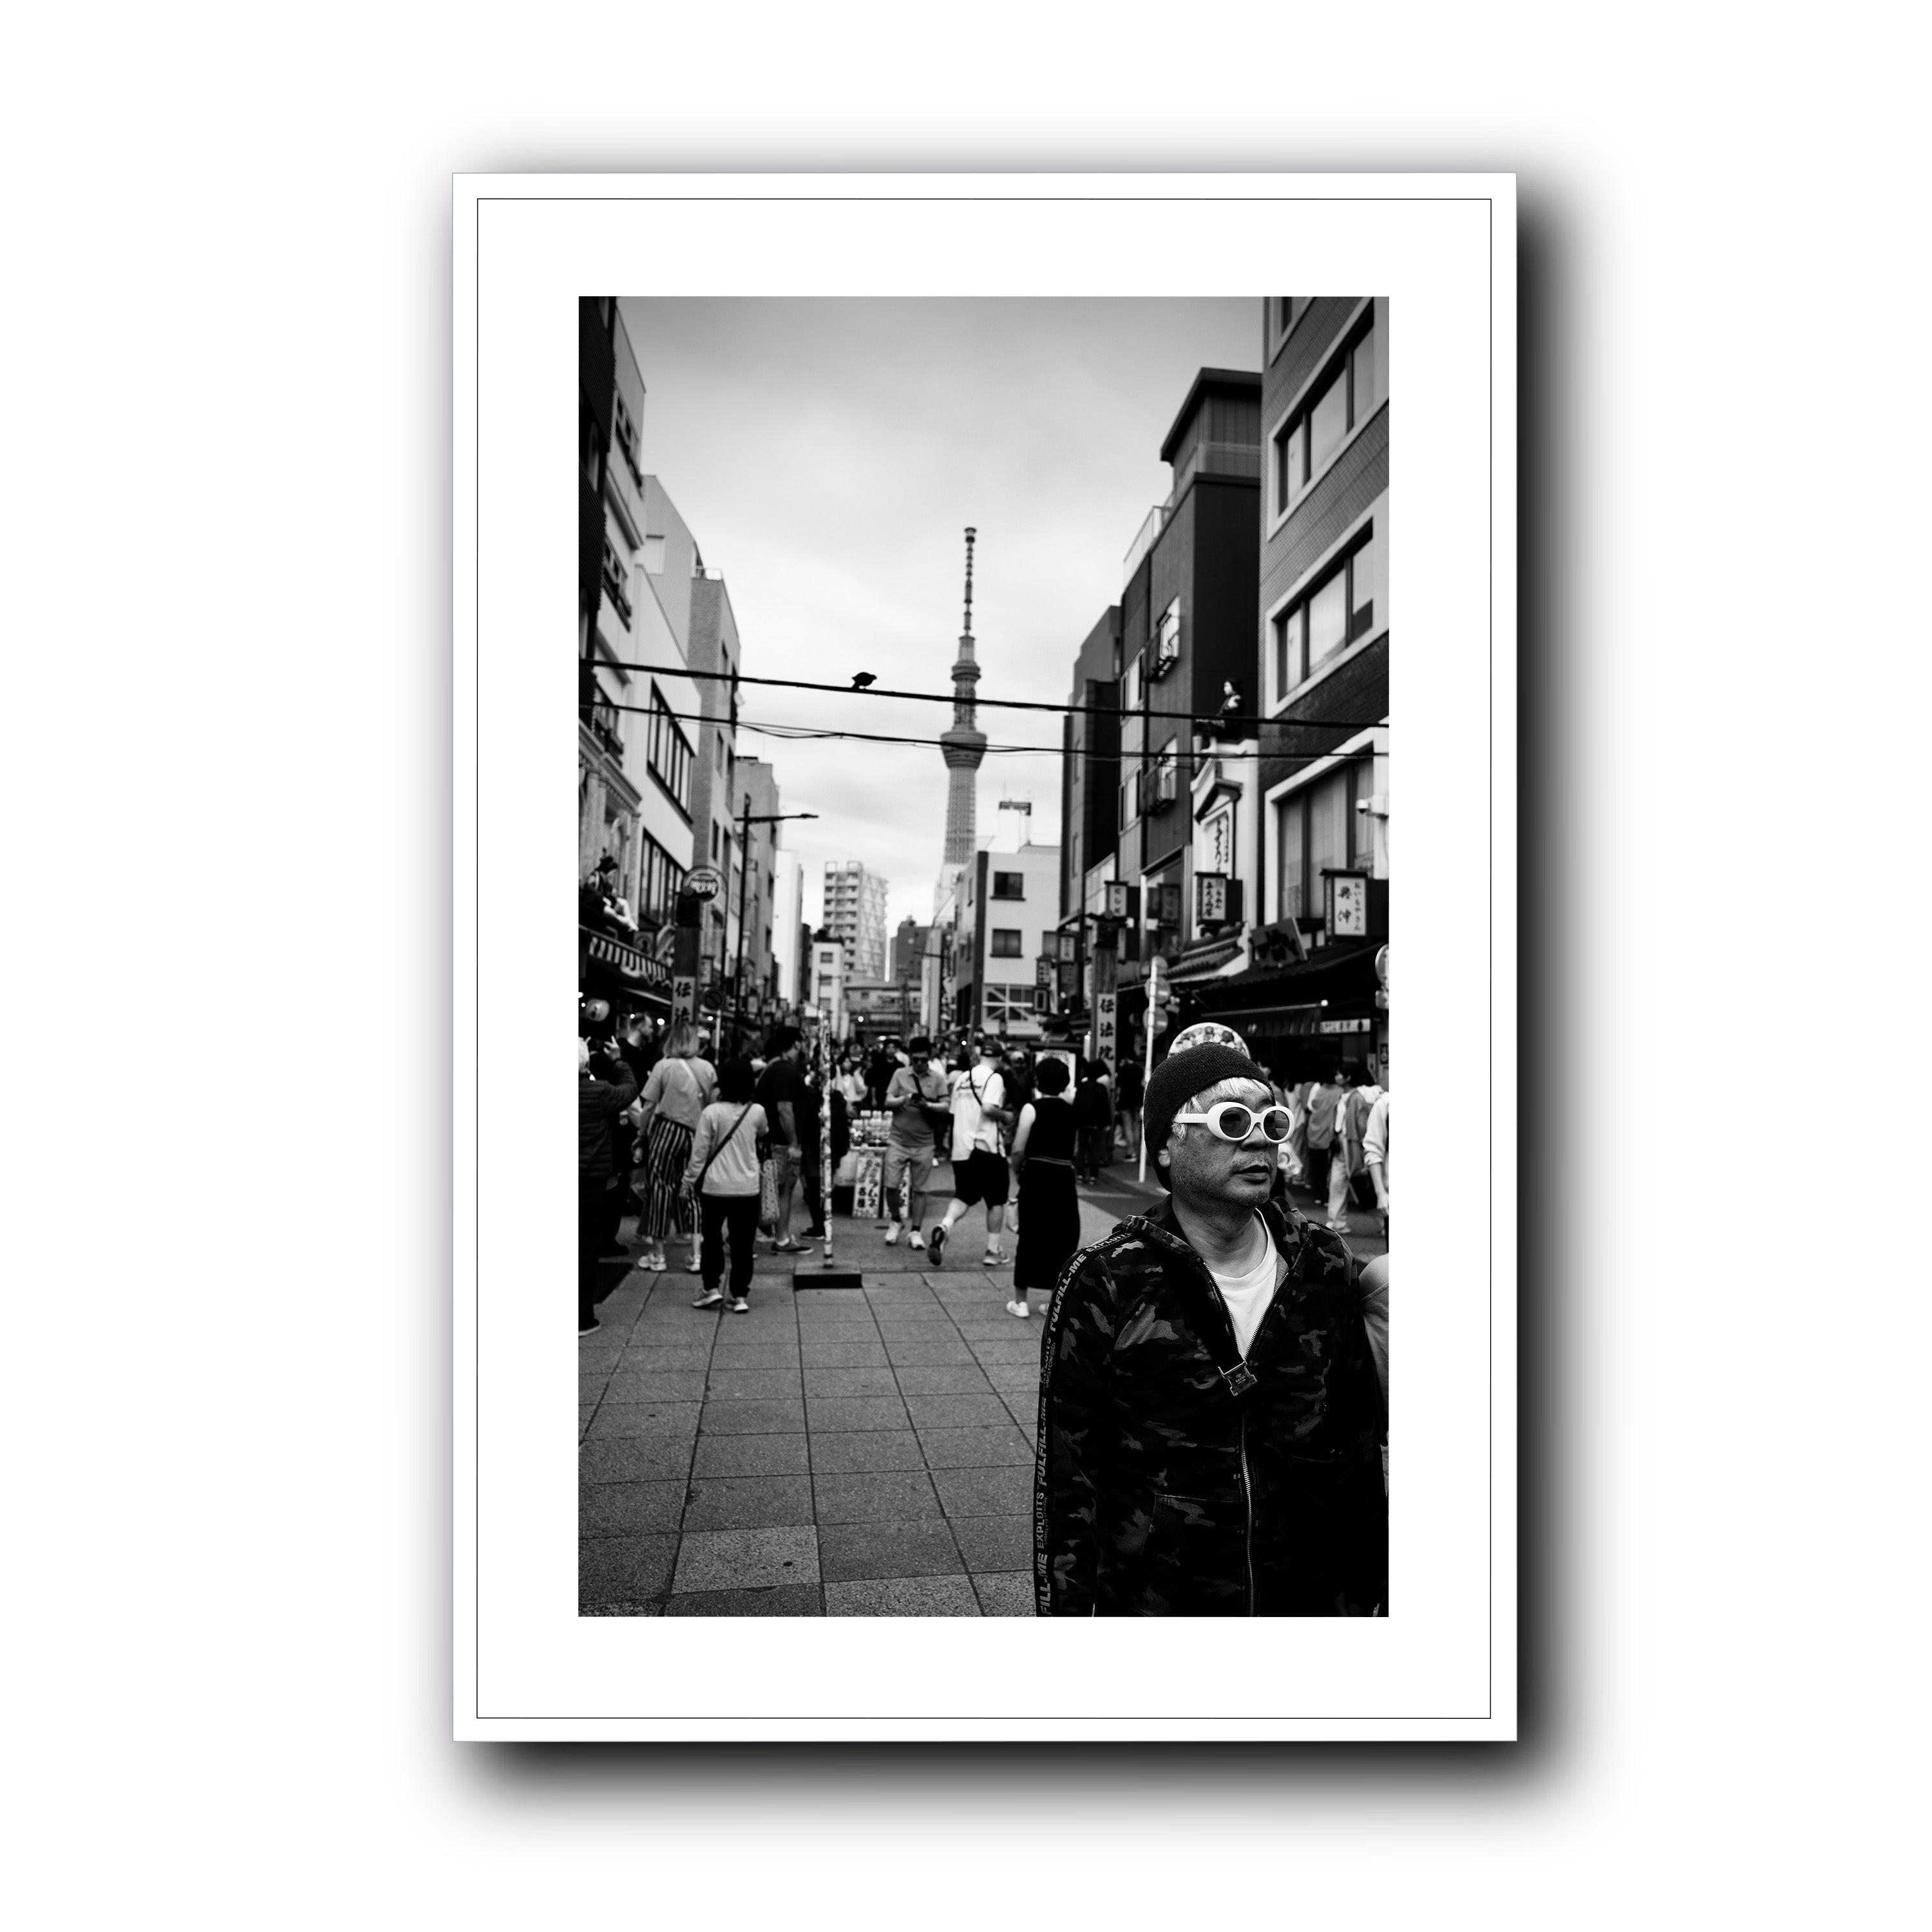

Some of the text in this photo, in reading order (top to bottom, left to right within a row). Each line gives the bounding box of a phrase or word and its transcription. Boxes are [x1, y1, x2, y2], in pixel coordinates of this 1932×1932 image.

[1049, 1253, 1087, 1332] FULFILL-ME
[1037, 1396, 1047, 1486] FULFILL-ME
[1036, 1492, 1045, 1549] EXPLOITS
